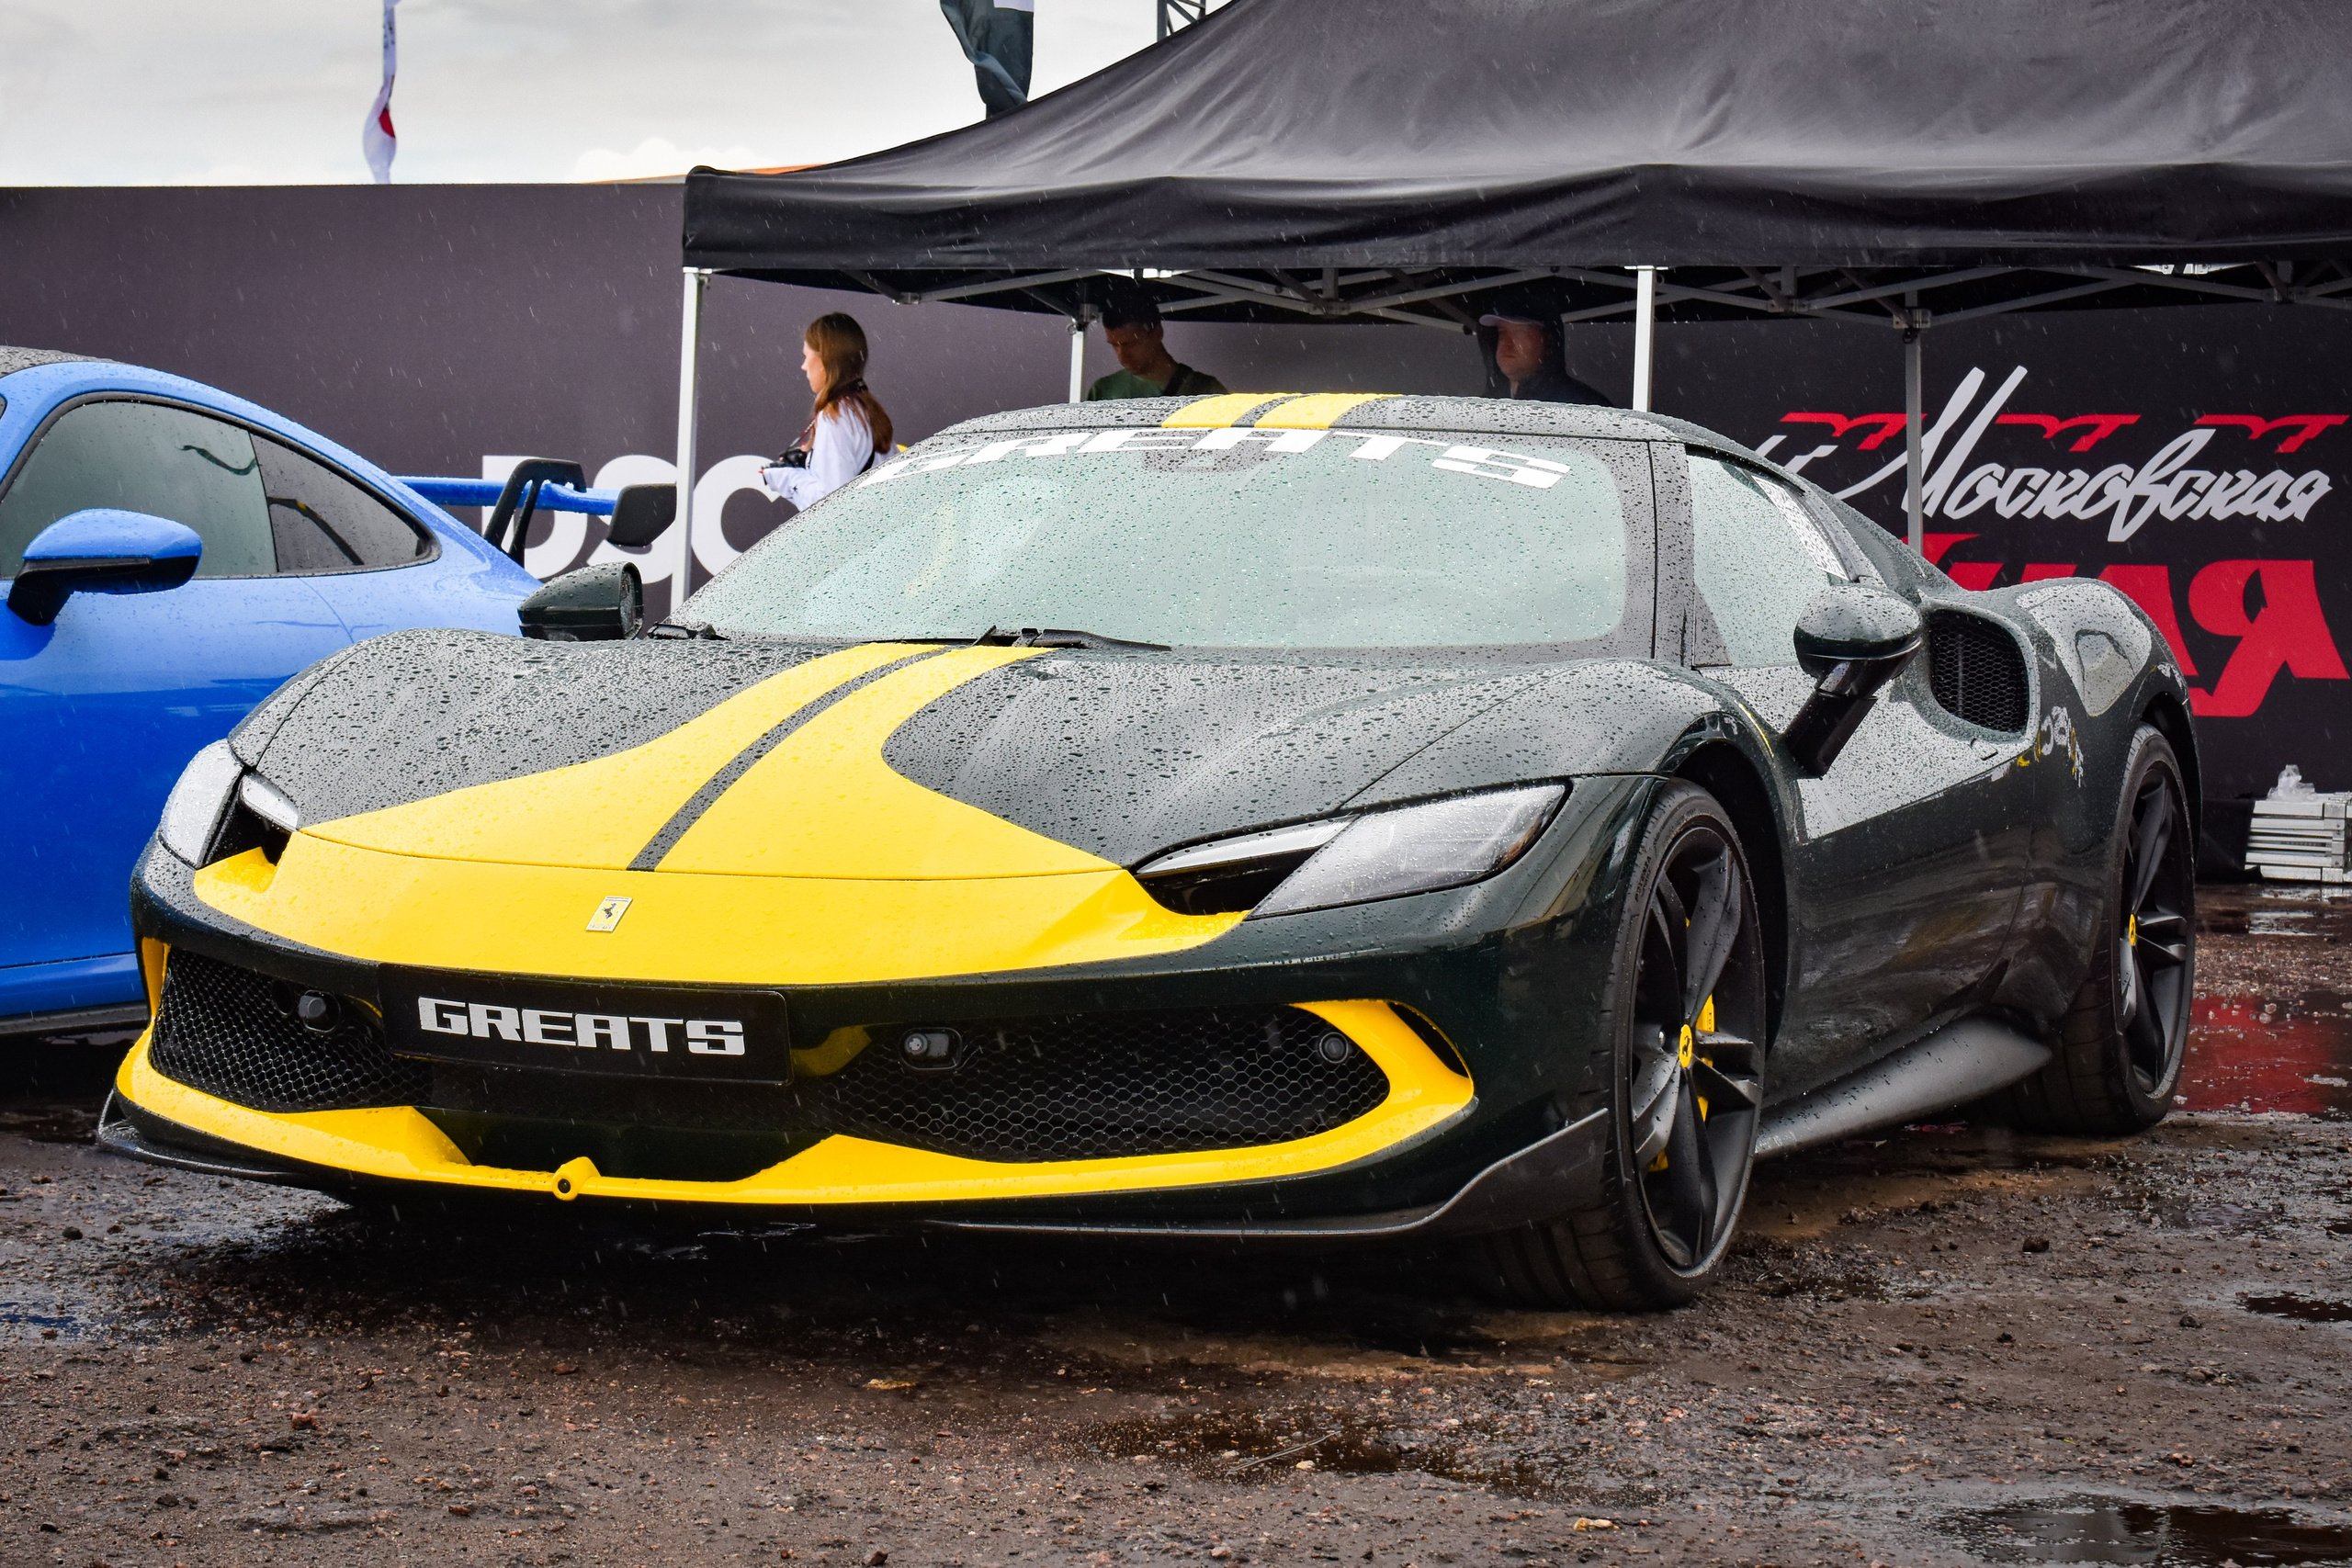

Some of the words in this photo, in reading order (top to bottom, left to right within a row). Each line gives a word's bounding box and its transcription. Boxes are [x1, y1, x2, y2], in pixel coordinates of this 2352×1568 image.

[857, 427, 1571, 490] GREATS
[1831, 366, 2334, 543] Московская
[418, 996, 745, 1055] GREATS
